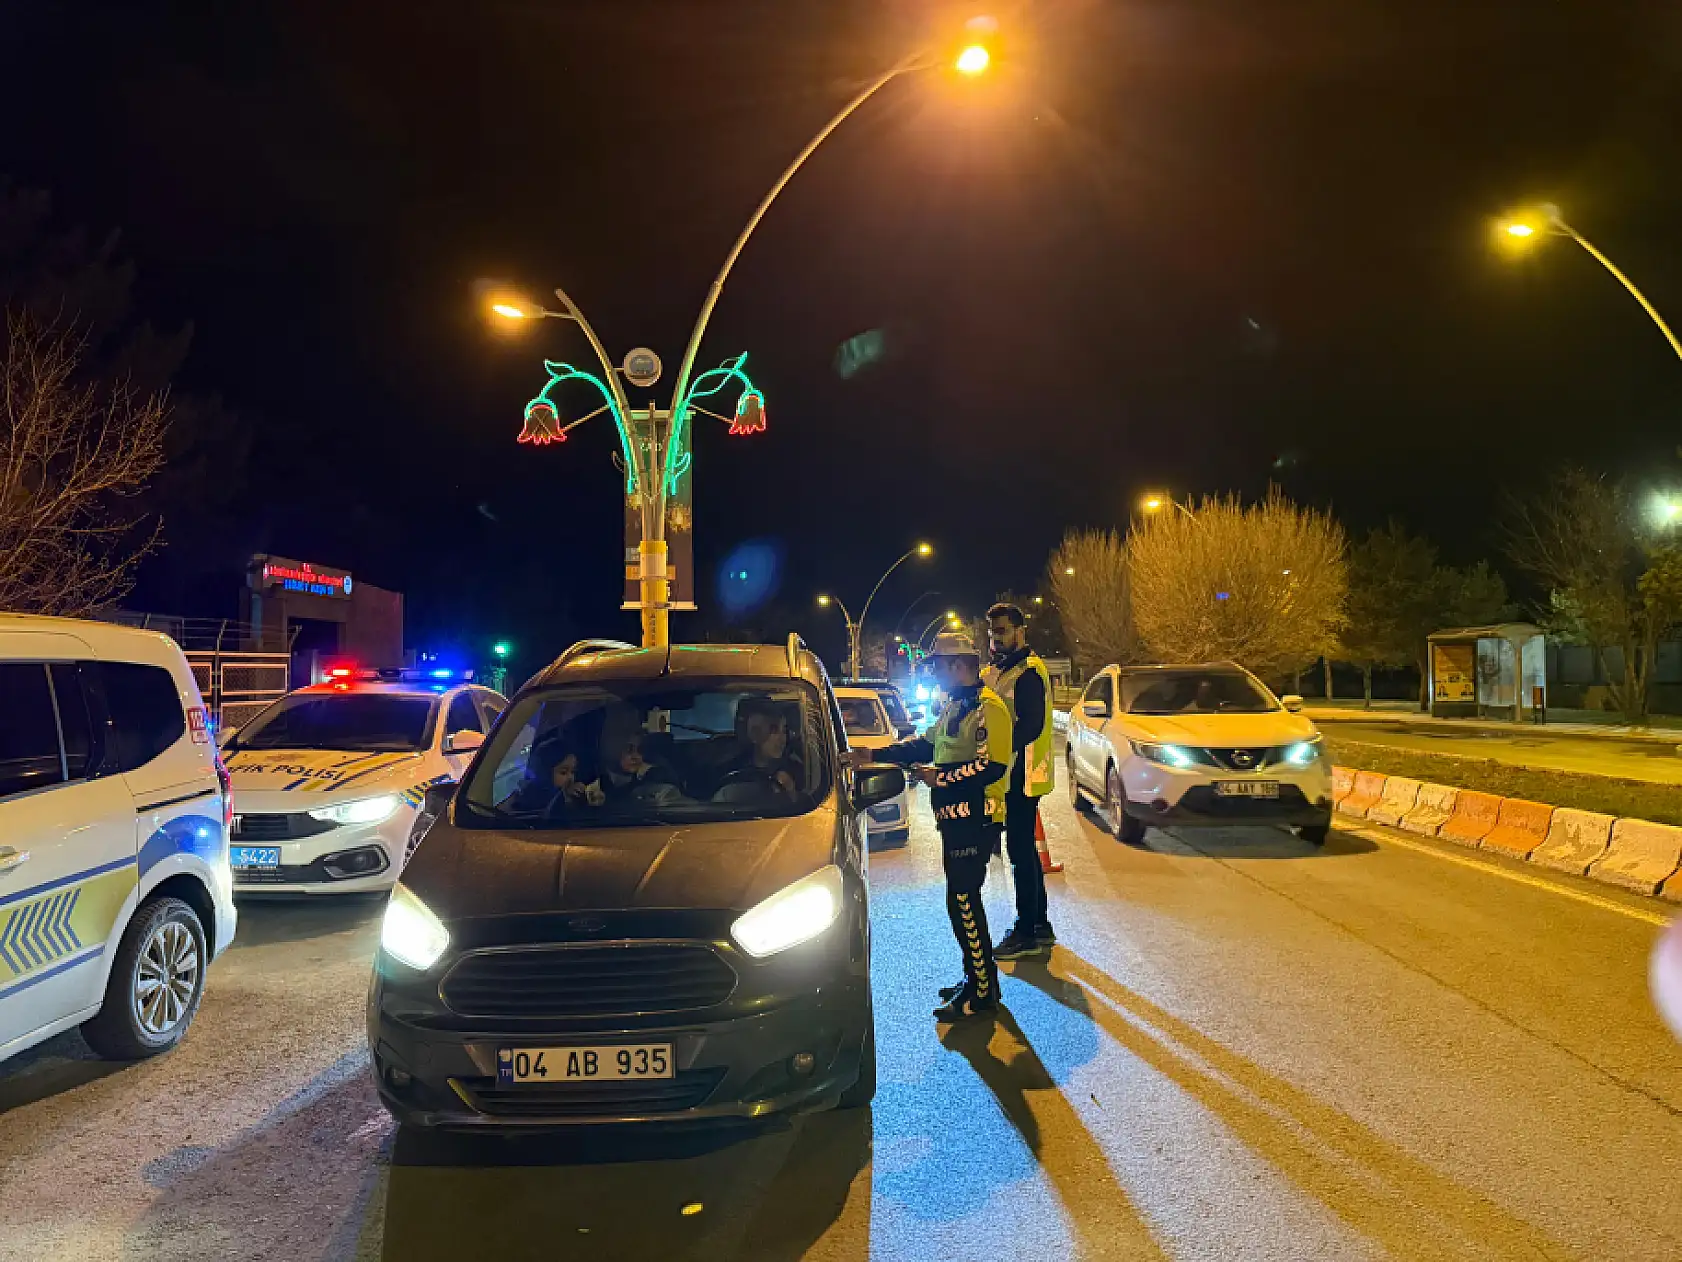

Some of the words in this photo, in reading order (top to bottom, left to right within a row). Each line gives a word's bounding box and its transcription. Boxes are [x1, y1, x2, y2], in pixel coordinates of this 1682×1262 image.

[240, 849, 276, 864] 5422
[515, 1051, 548, 1079] 04
[566, 1050, 599, 1077] AB
[617, 1048, 667, 1076] 935
